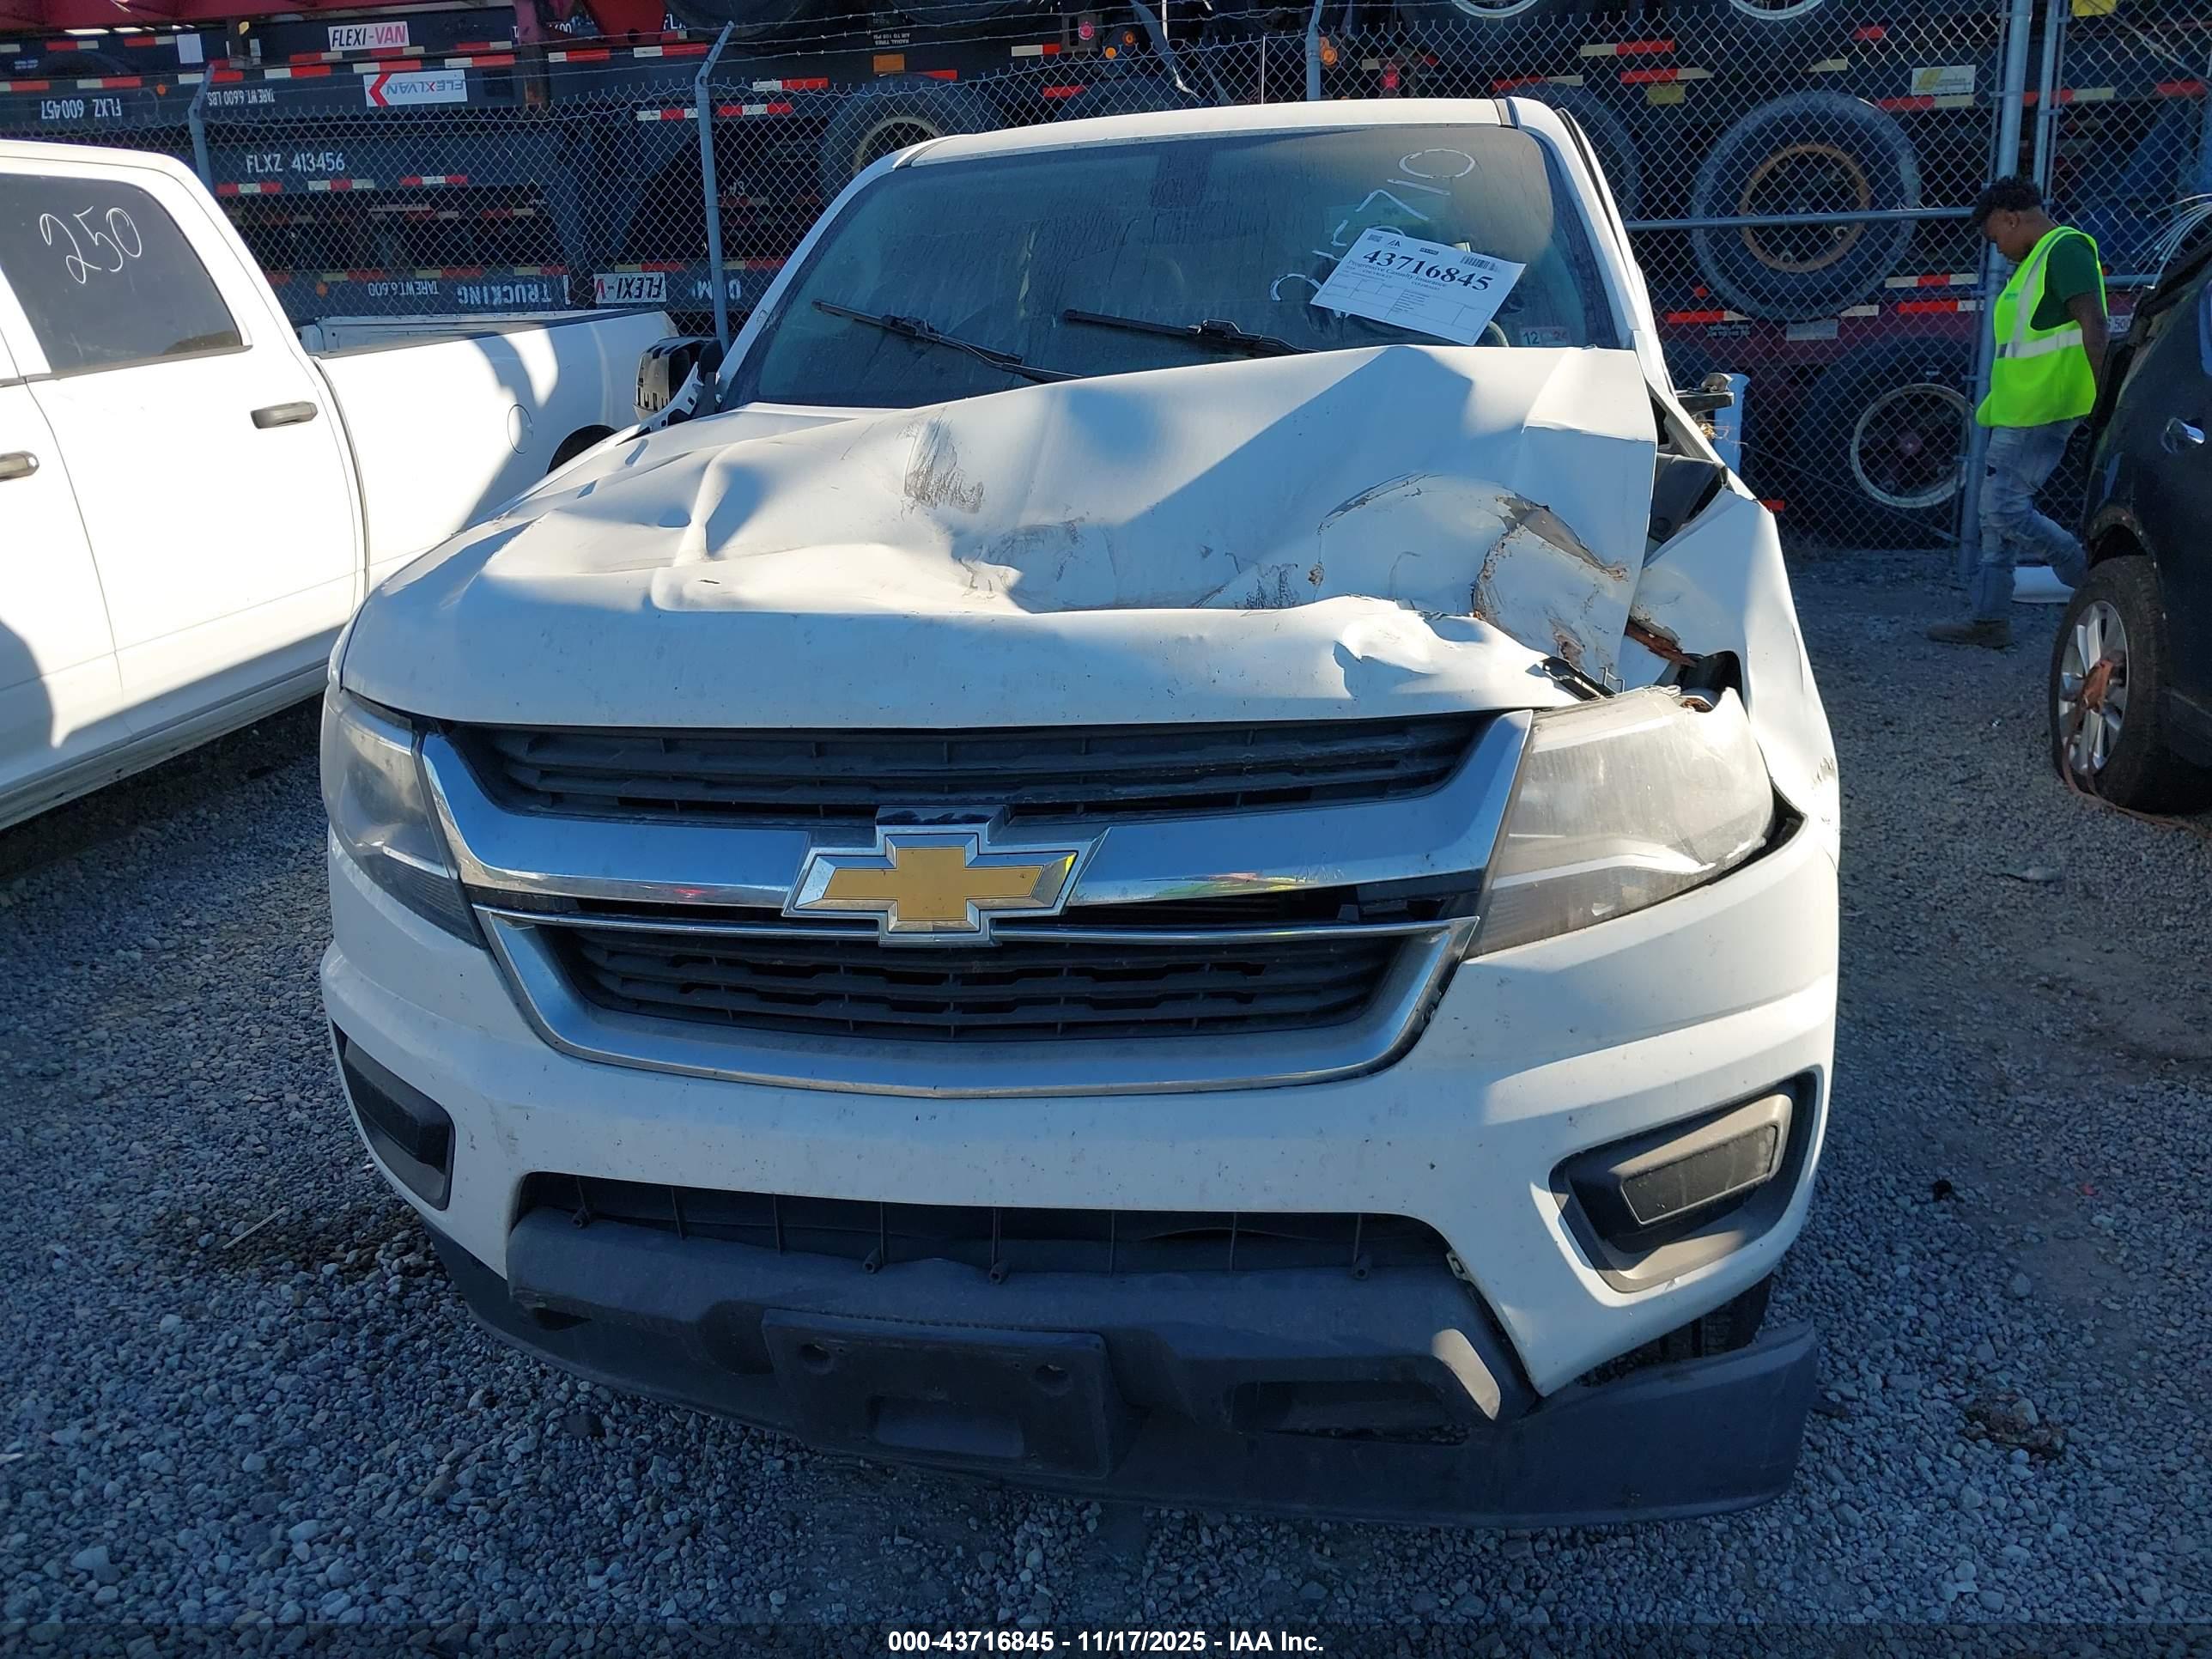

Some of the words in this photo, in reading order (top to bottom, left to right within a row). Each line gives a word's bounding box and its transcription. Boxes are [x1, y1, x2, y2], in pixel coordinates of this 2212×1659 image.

[258, 88, 276, 103] TARE
[40, 99, 84, 120] 600457
[94, 98, 122, 117] FLXZ
[246, 154, 283, 173] FLXZ
[291, 151, 345, 173] 413456
[40, 205, 142, 284] 250
[1363, 250, 1493, 291] 43716845
[457, 282, 552, 306] TRUCKING
[1523, 331, 1540, 345] 12
